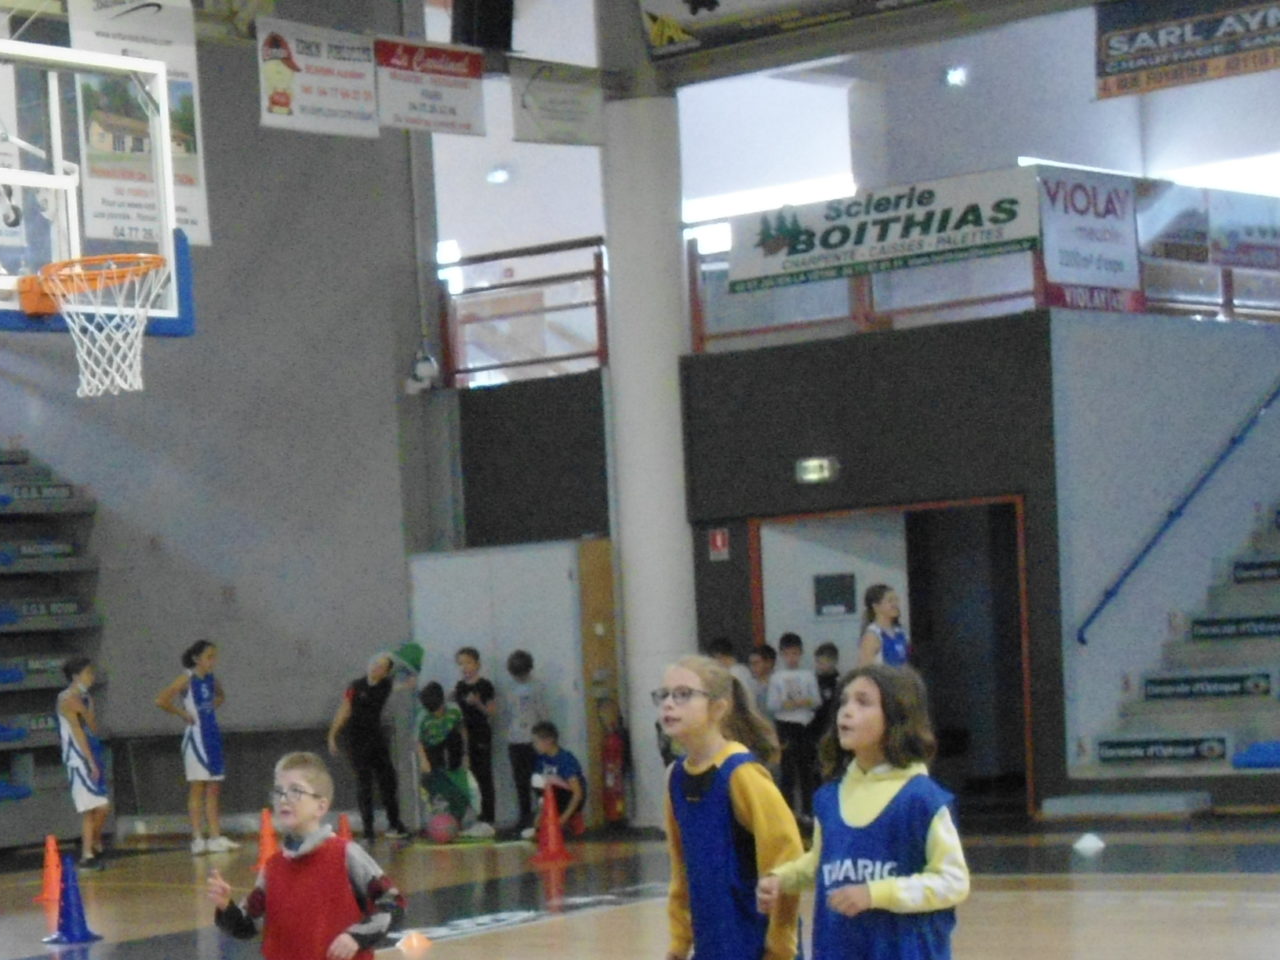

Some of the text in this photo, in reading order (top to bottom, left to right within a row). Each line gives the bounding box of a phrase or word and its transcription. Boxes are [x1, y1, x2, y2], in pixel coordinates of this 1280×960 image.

[1109, 23, 1202, 56] SARL
[824, 187, 935, 221] Scierie
[1043, 180, 1128, 220] VIOLAY
[786, 198, 1019, 255] BOITHIAS
